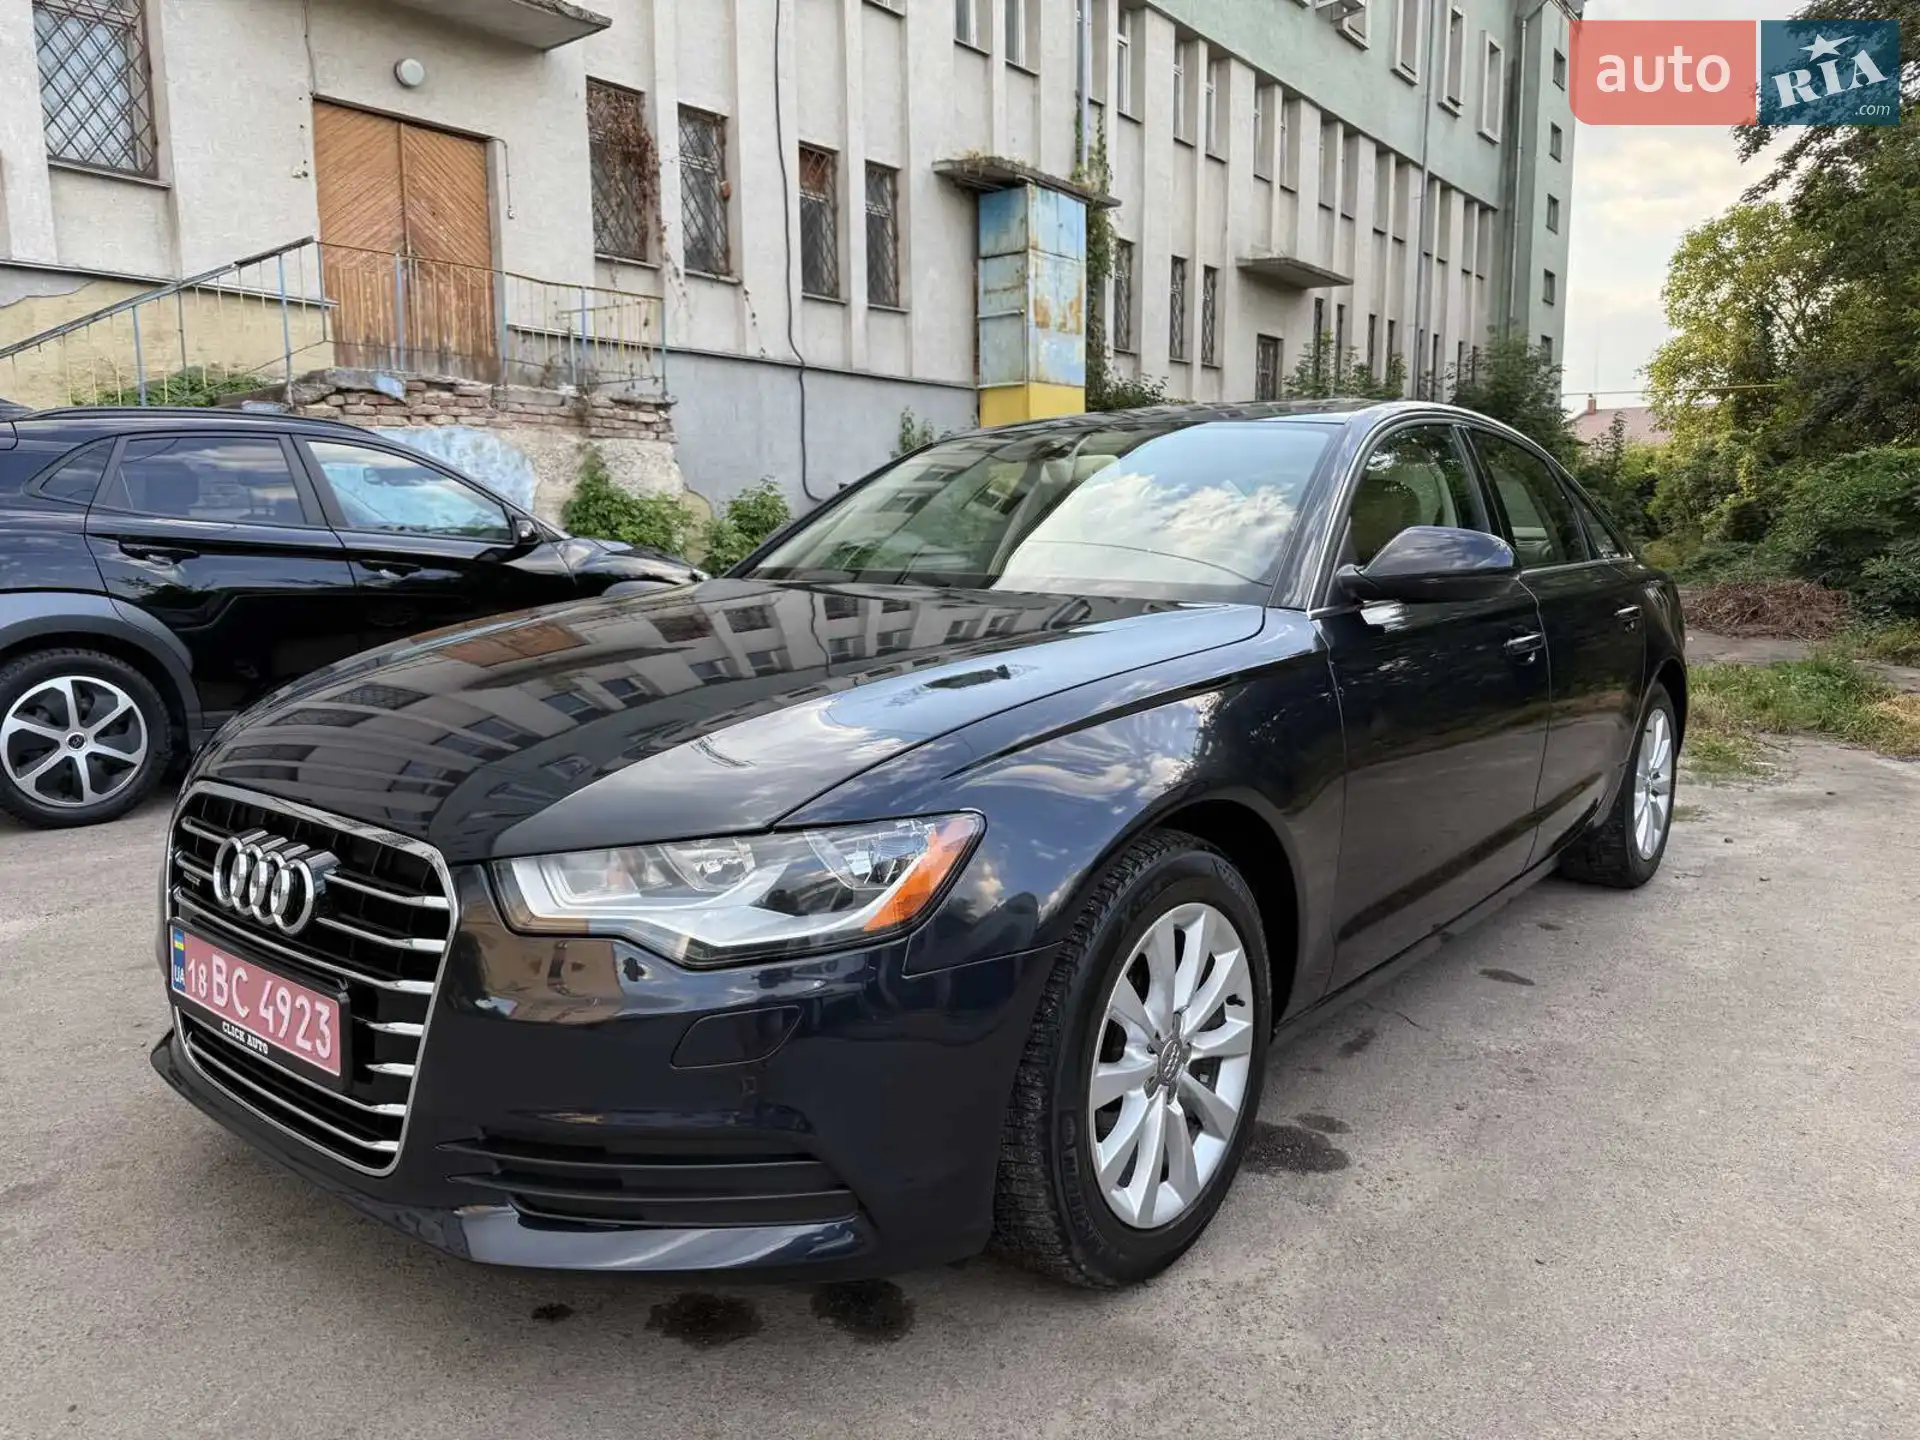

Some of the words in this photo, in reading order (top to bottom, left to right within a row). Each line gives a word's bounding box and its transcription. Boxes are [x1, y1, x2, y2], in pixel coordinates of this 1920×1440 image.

[174, 964, 186, 984] UA
[187, 958, 207, 999] 18
[211, 953, 250, 1018] BC
[259, 979, 331, 1059] 4923
[222, 1020, 246, 1043] CLICK
[246, 1033, 269, 1055] AUTO
